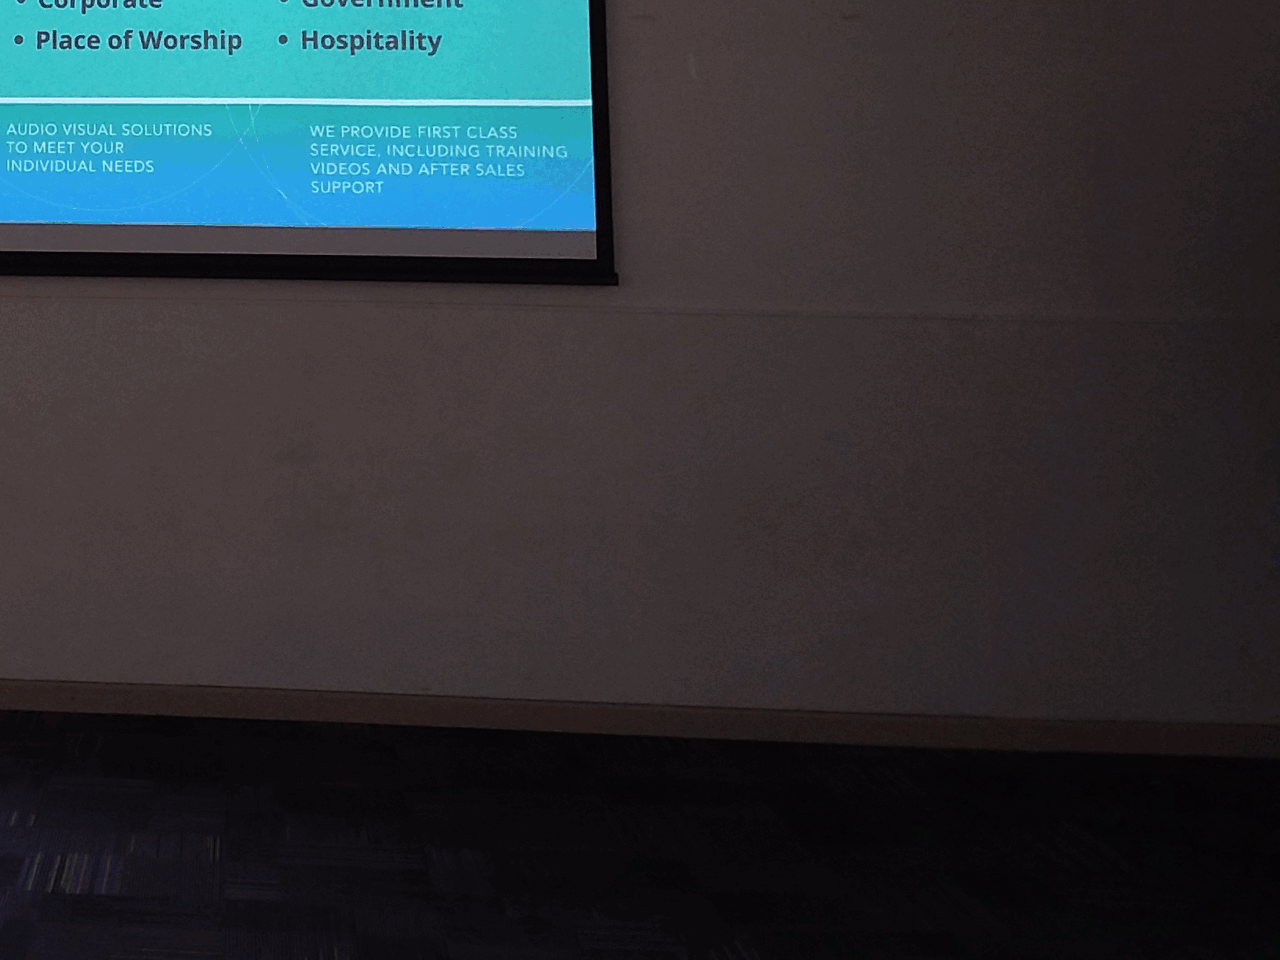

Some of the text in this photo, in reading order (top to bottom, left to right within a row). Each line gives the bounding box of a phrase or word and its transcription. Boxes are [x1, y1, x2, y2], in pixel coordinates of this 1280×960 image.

[36, 29, 243, 55] Place of Worship
[301, 30, 443, 56] Hospitality
[6, 123, 213, 137] AUDIO VISUAL SOLUTIONS
[309, 125, 518, 140] WE PROVIDE FIRST CLASS
[6, 141, 125, 155] TO MEET YOUR
[309, 143, 568, 159] SERVICE, INCLUDING TRAINING
[6, 159, 155, 173] INDIVIDUAL NEEDS
[310, 162, 525, 177] VIDEOS AND AFTER SALES
[310, 180, 384, 195] SUPPORT
